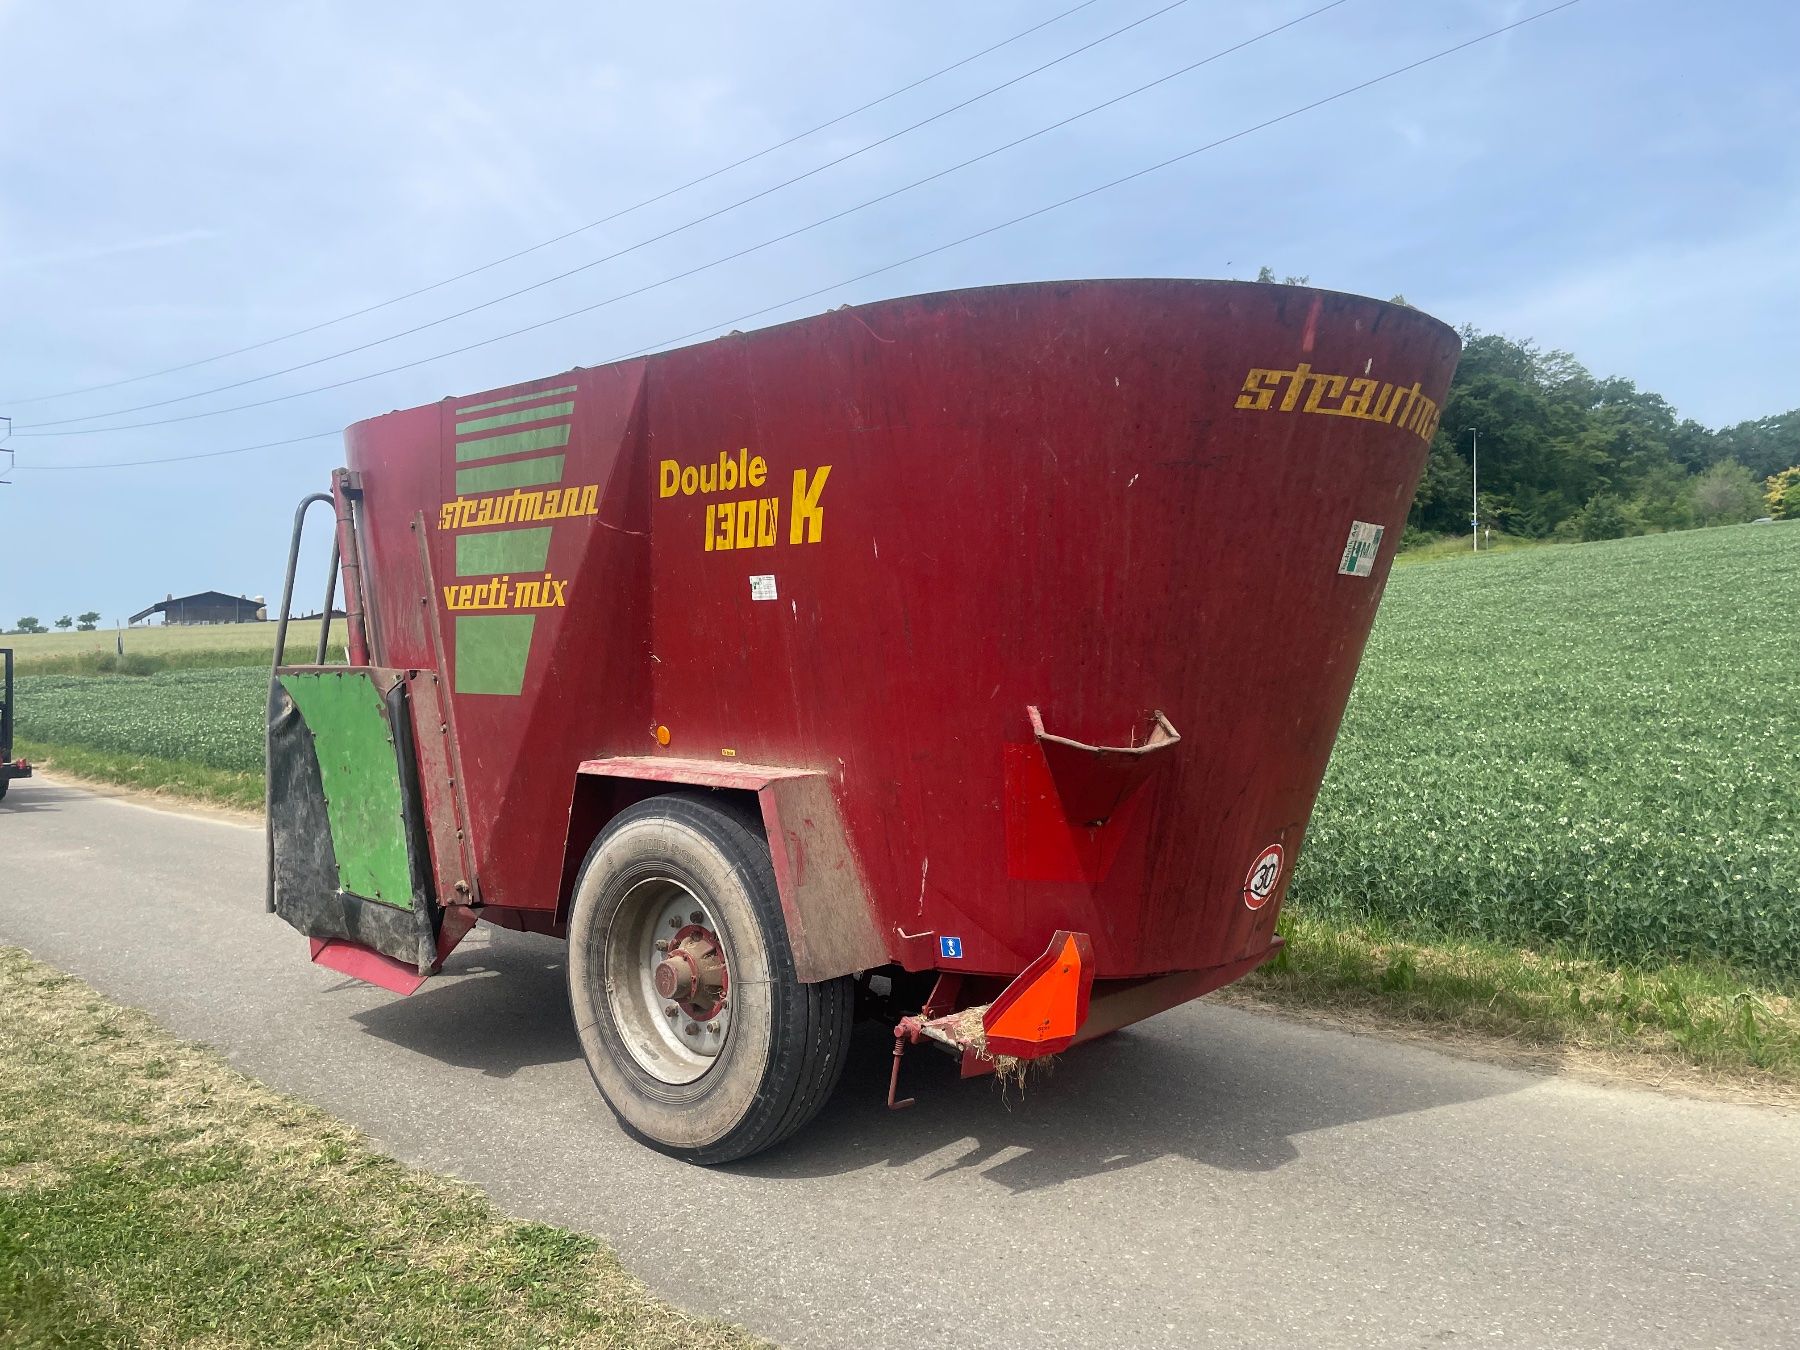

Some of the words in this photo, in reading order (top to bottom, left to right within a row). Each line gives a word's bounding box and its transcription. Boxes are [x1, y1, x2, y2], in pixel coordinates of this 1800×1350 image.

[660, 448, 767, 498] Double
[438, 485, 598, 530] strautmann
[705, 497, 778, 551] 1300
[790, 465, 832, 544] K
[443, 573, 567, 610] verti-mix
[1254, 864, 1275, 890] 30
